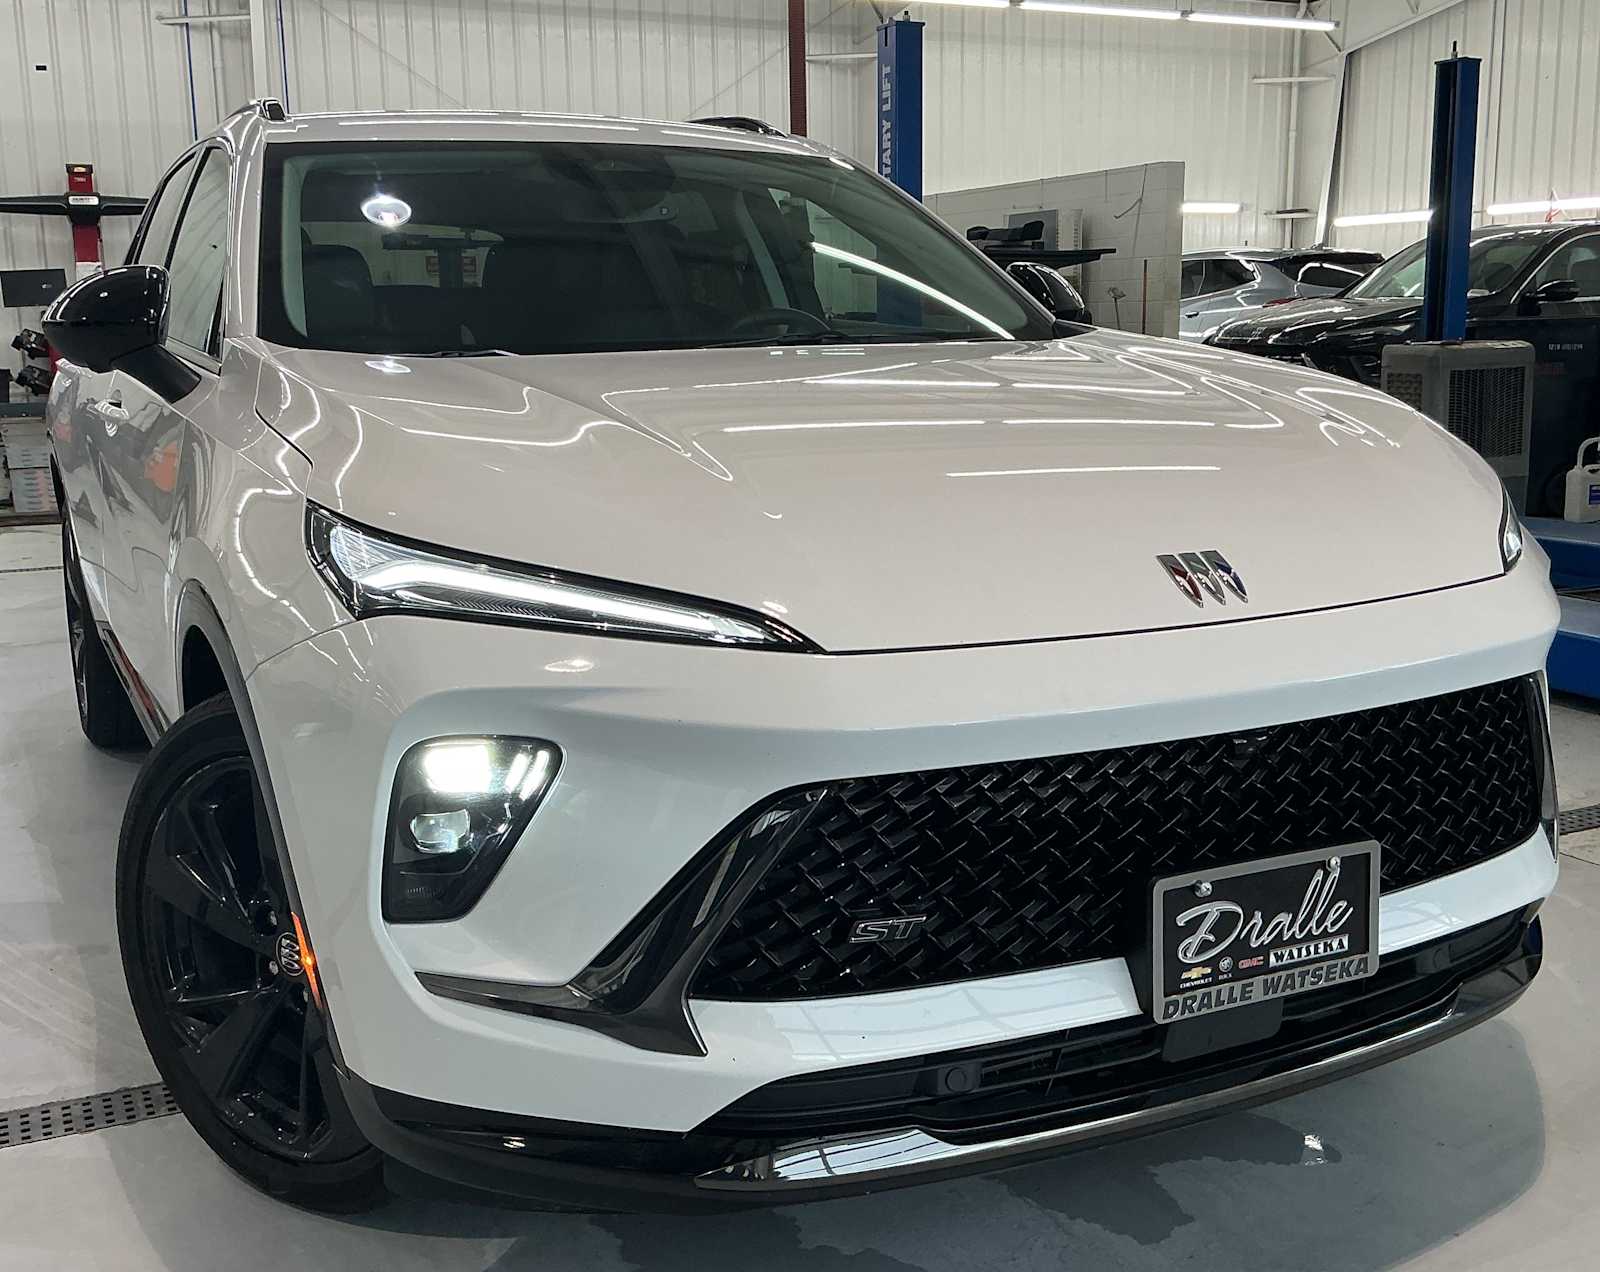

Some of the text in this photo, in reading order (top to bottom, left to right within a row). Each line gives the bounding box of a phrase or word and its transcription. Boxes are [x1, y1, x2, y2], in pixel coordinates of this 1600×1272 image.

[882, 64, 891, 181] TARY LIFT
[849, 914, 927, 944] ST
[1176, 867, 1354, 964] Dralle
[1273, 938, 1346, 963] WATSEKA
[1162, 957, 1369, 1020] DRALLE WATSEKA
